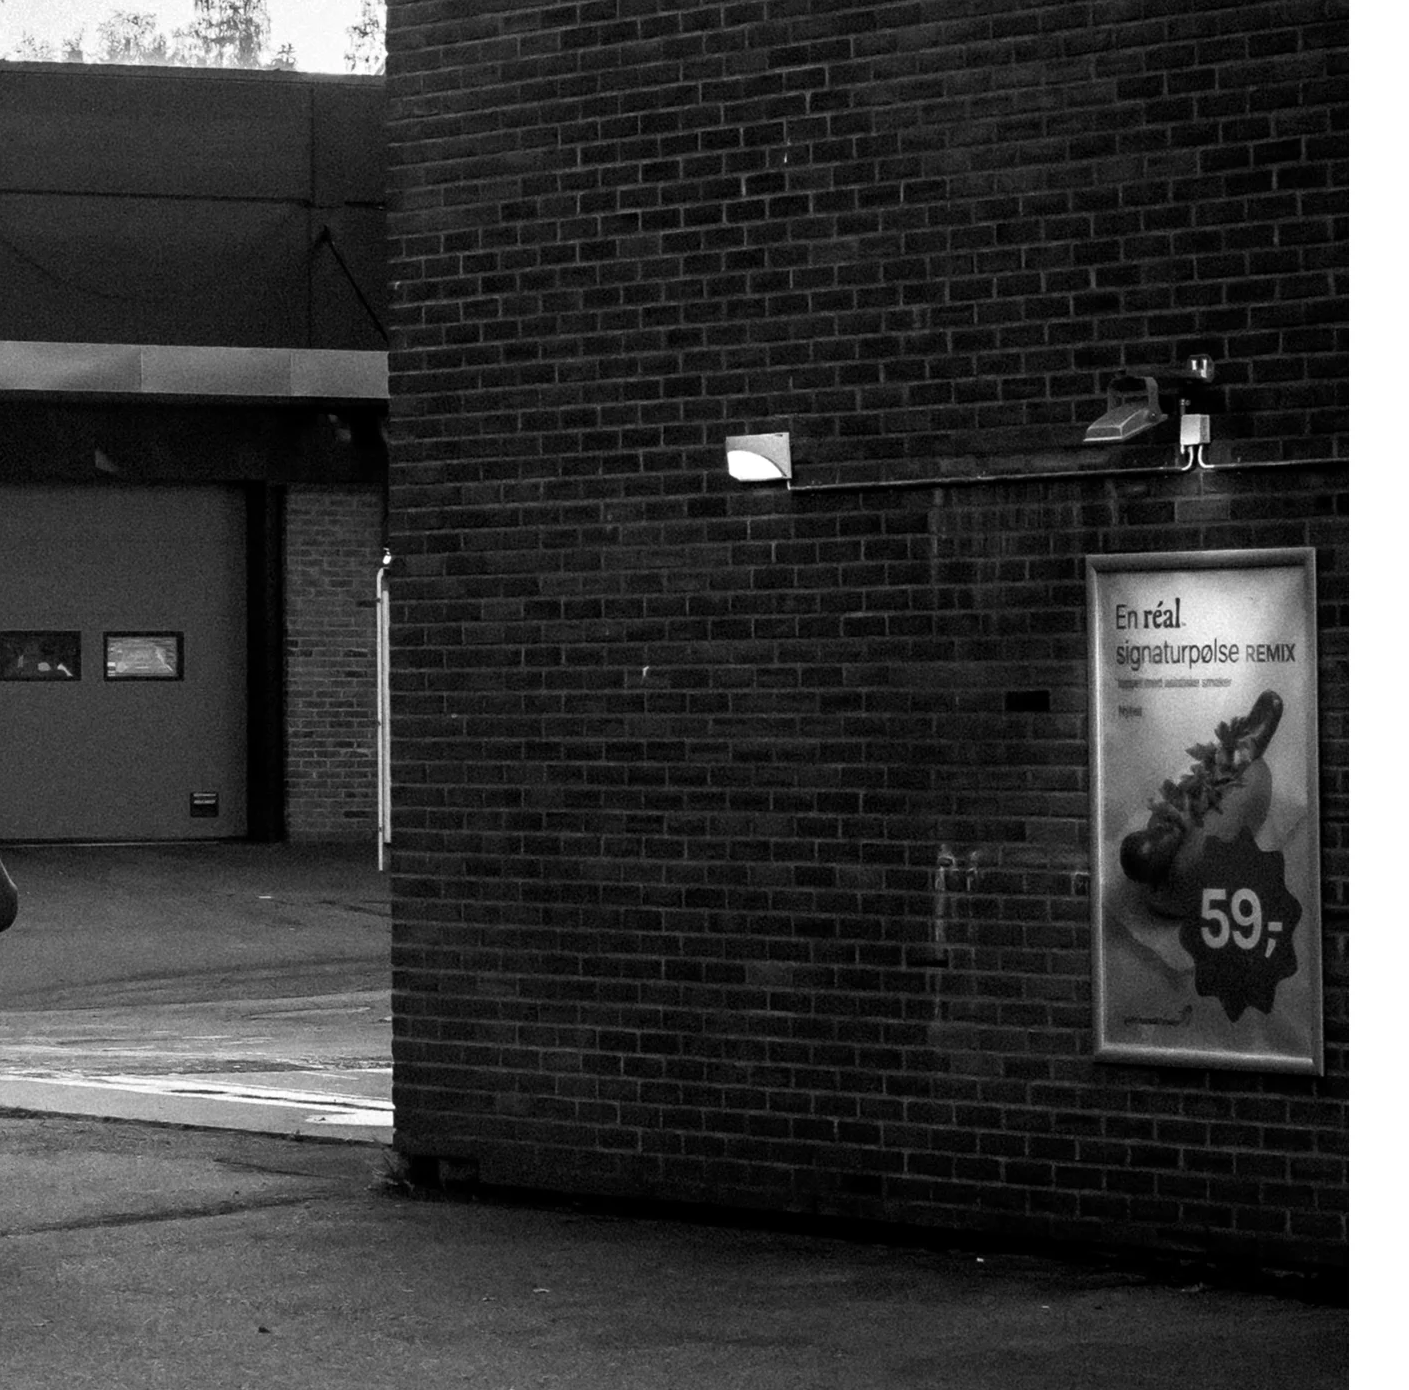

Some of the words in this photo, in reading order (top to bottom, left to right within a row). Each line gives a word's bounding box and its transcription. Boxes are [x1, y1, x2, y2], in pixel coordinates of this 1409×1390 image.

[1115, 604, 1138, 630] En
[1143, 597, 1181, 629] réal
[1115, 638, 1240, 671] signaturpølse
[1245, 643, 1296, 662] REMIX
[1201, 888, 1283, 959] 59,-
